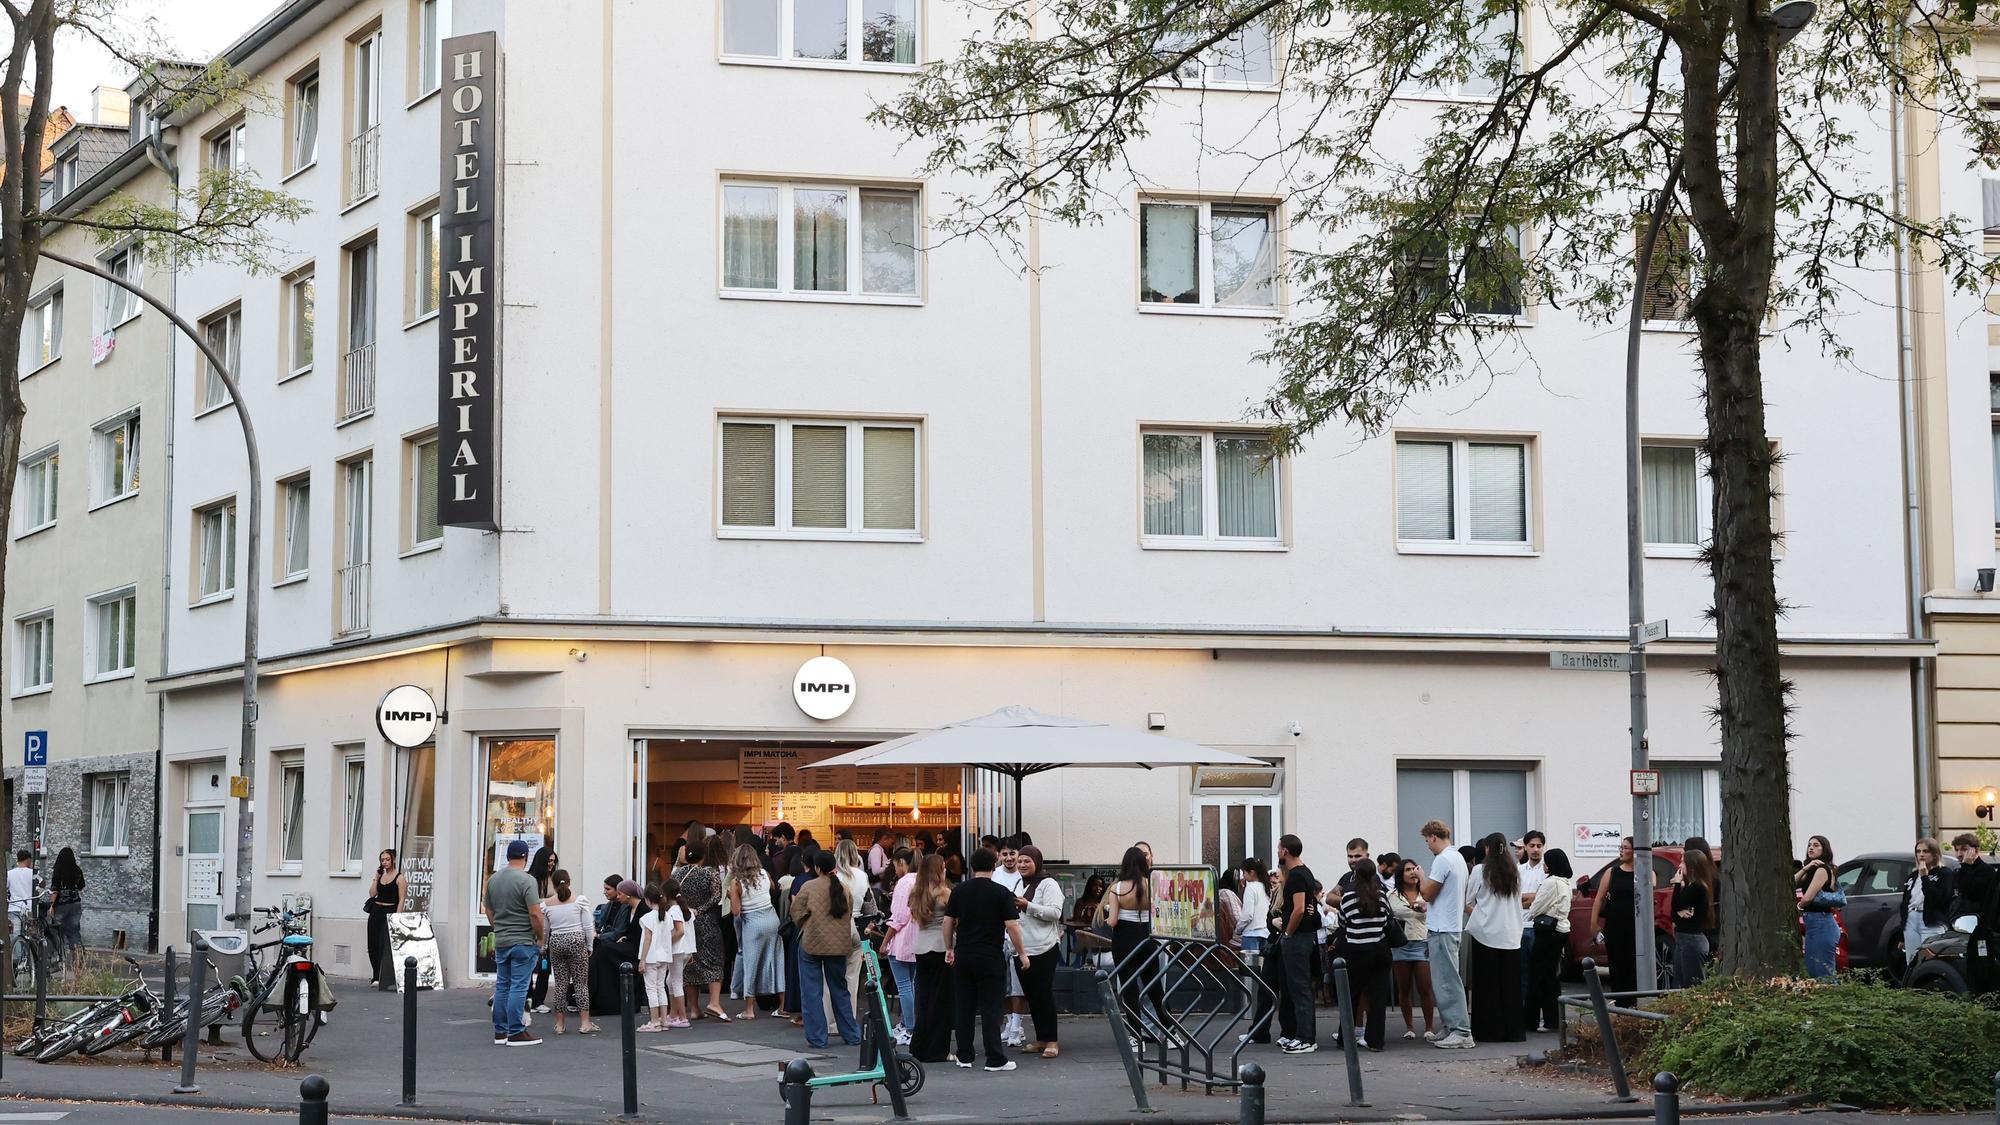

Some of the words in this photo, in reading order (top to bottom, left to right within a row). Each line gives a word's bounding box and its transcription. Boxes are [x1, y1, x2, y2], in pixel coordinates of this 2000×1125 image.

[452, 50, 483, 215] HOTEL
[447, 234, 485, 502] IMPERIAL
[1562, 653, 1620, 668] Barthelstr.
[801, 682, 850, 693] IMPI
[385, 711, 432, 722] IMPI
[28, 735, 41, 762] P
[402, 858, 416, 870] NOT
